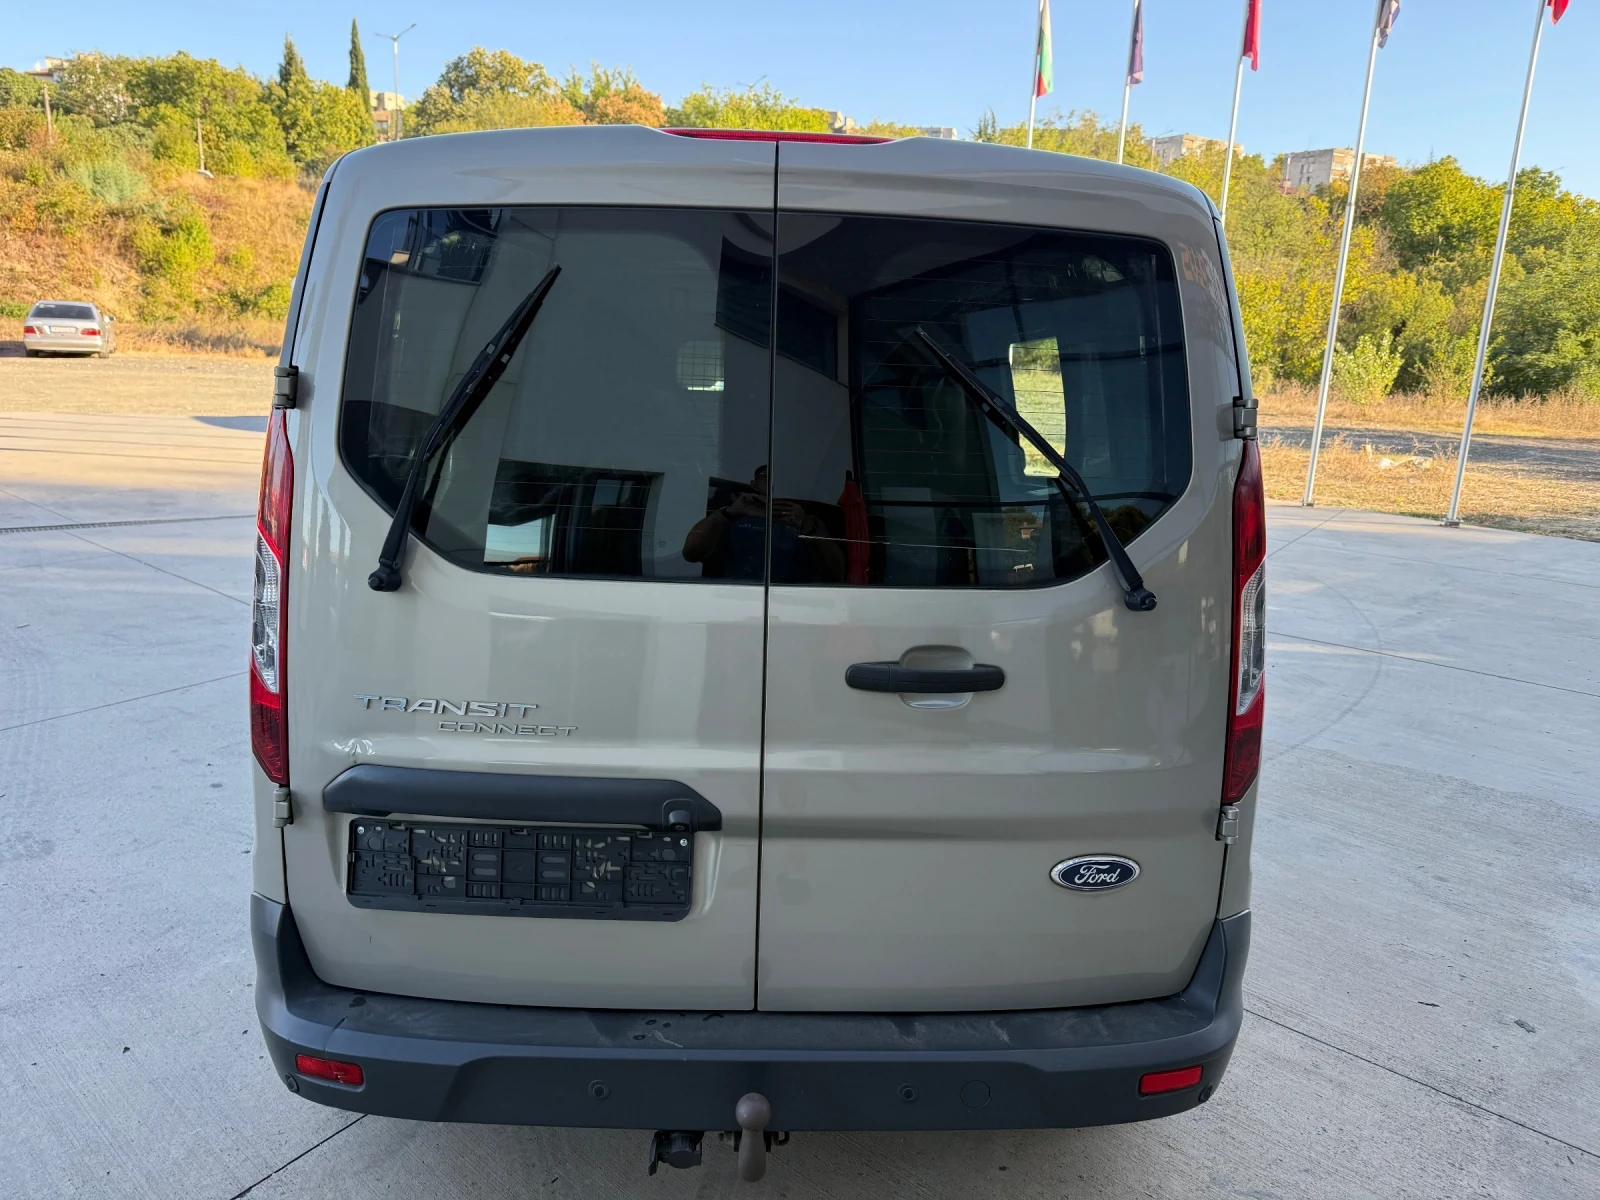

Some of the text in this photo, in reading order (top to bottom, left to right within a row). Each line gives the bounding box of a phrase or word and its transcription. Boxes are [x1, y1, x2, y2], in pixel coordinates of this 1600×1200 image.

[353, 694, 539, 719] TRANSIT
[438, 720, 578, 737] CONNECT
[1074, 864, 1121, 884] Ford
